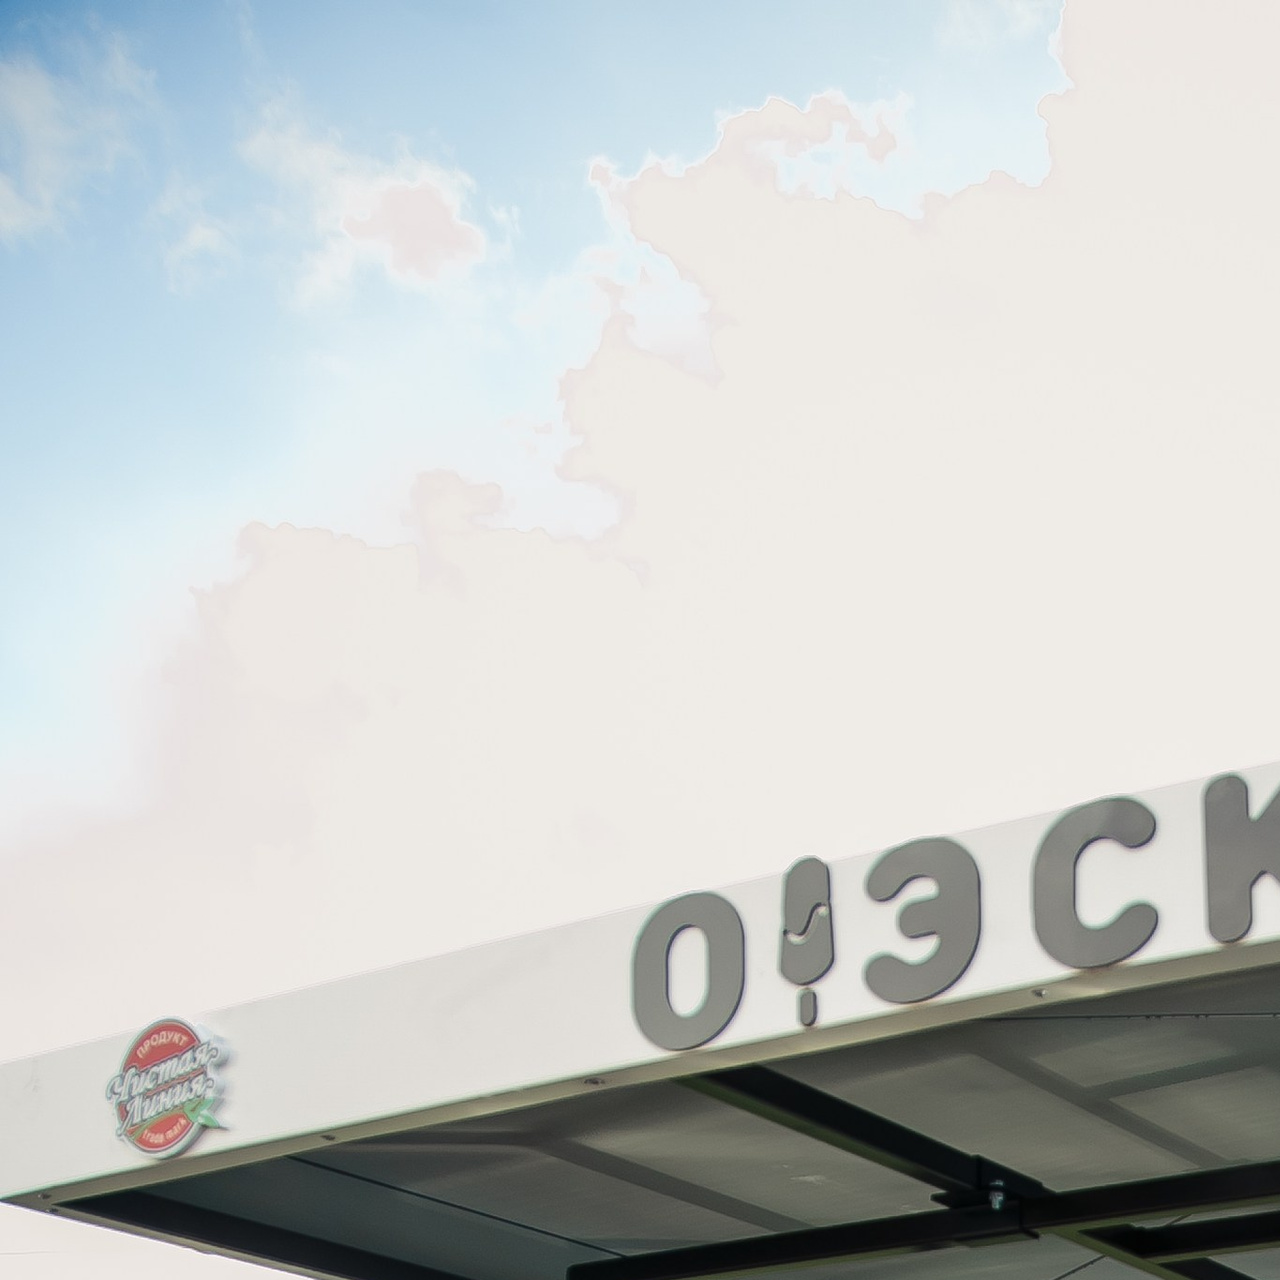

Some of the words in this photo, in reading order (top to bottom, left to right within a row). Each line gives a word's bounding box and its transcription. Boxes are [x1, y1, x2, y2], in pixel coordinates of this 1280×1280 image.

[106, 1044, 218, 1100] Чистая
[136, 1031, 188, 1058] ПРОДУКТ
[116, 1075, 214, 1136] Линия
